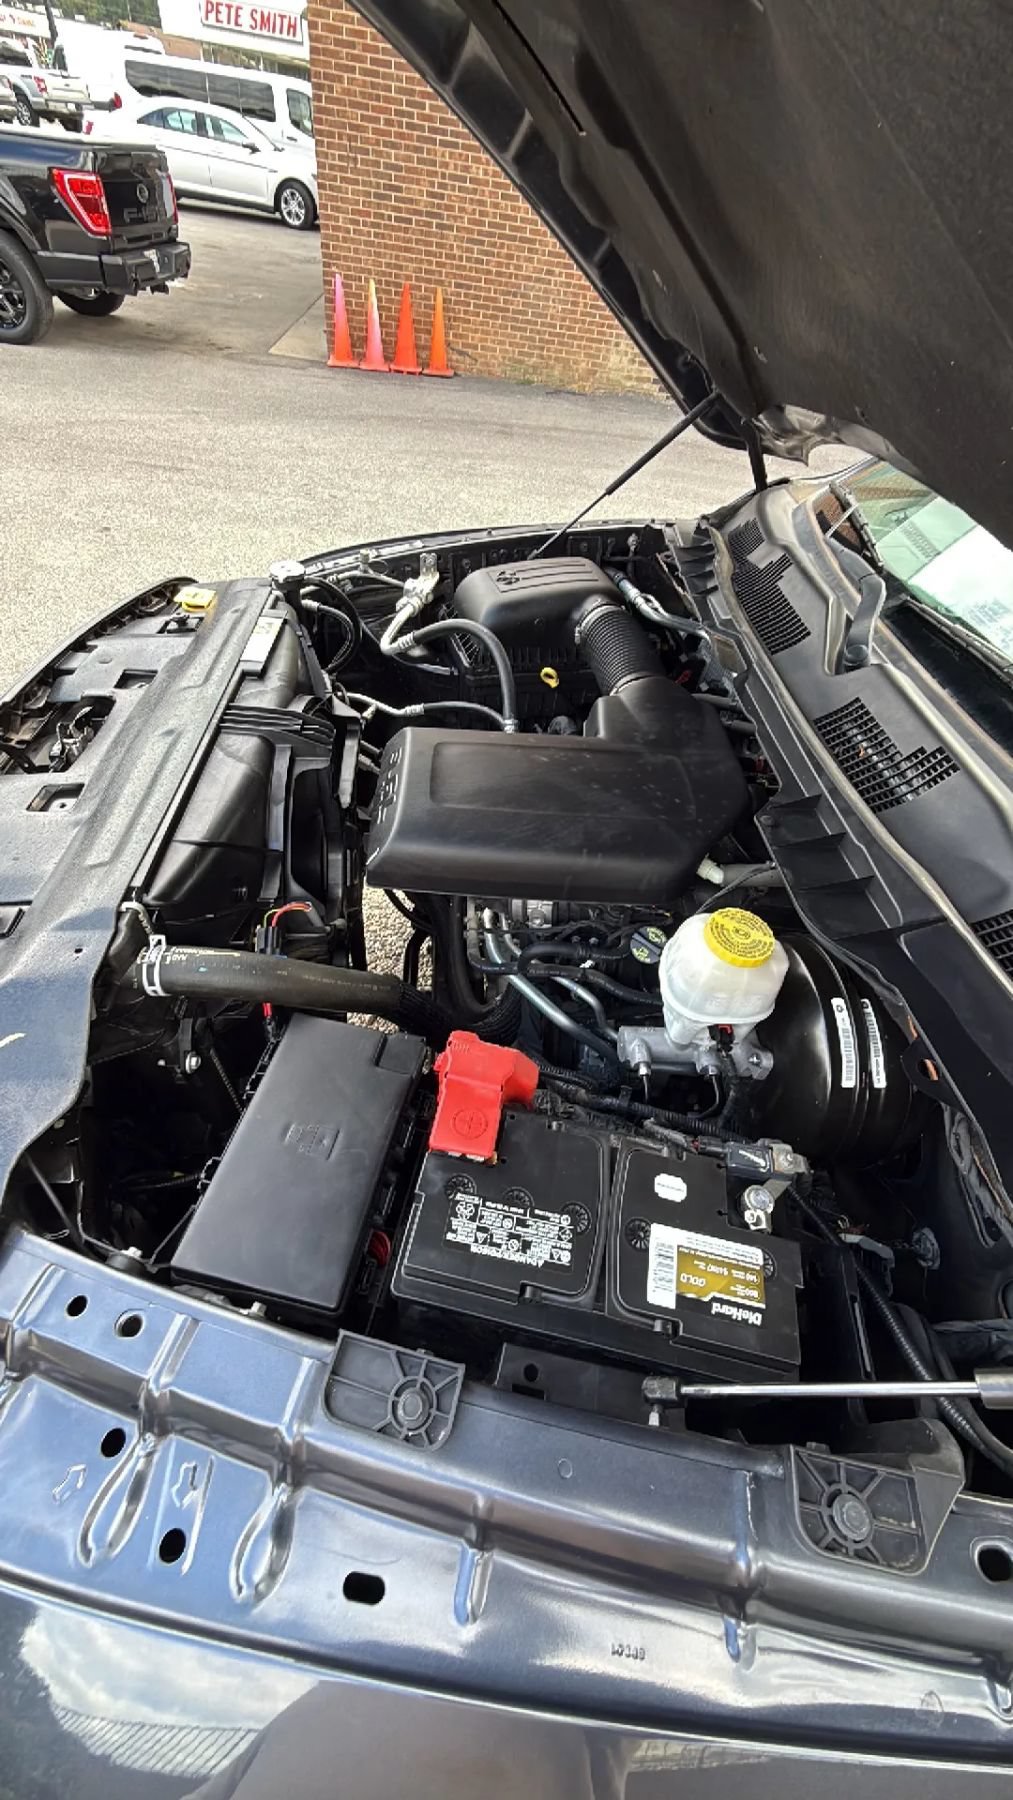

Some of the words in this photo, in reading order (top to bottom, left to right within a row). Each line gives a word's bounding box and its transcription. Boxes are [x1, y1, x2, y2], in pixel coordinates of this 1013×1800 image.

[205, 0, 243, 27] PETE
[249, 8, 298, 38] SMITH
[680, 1273, 706, 1287] GOLD
[711, 1302, 762, 1326] DieHard
